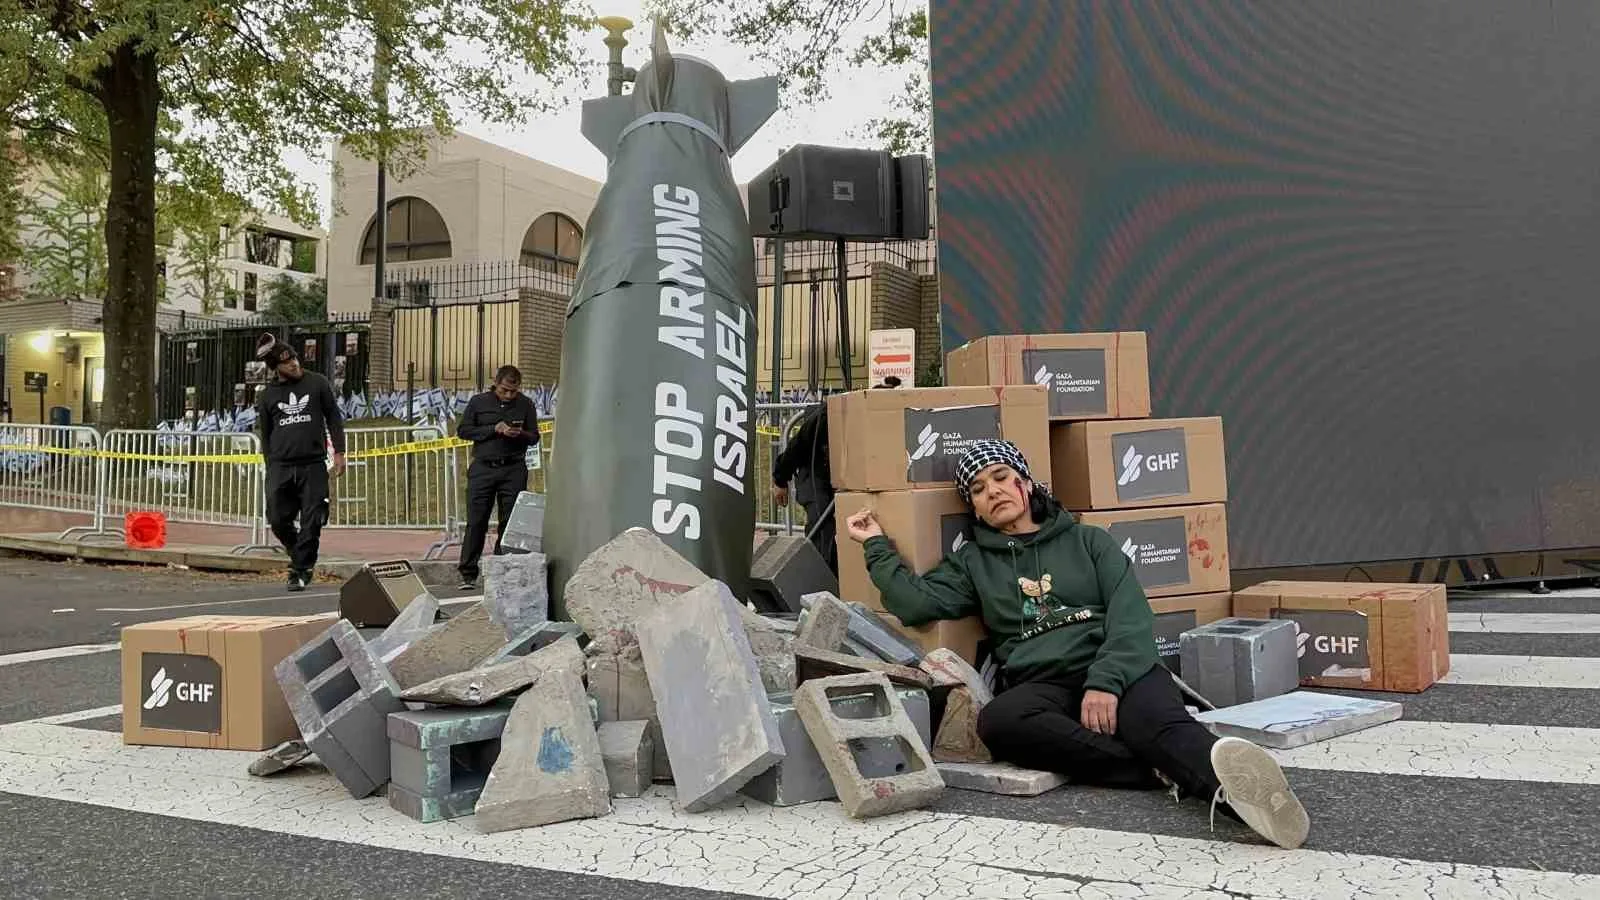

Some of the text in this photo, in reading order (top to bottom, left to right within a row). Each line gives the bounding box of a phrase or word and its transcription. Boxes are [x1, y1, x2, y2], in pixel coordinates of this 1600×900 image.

[652, 183, 706, 540] STOP ARMING
[1055, 379, 1101, 387] HUMANITARIAN
[713, 306, 747, 495] ISRAEL
[279, 413, 312, 426] adidas
[942, 432, 962, 440] GAZA
[943, 447, 969, 455] FOUND
[1145, 452, 1180, 472] GHF
[1139, 543, 1155, 551] GAZA
[1140, 548, 1181, 558] HUMANITARIAN
[1141, 555, 1176, 565] FOUNDATION
[1313, 634, 1361, 655] GHF
[175, 681, 215, 703] GHF
